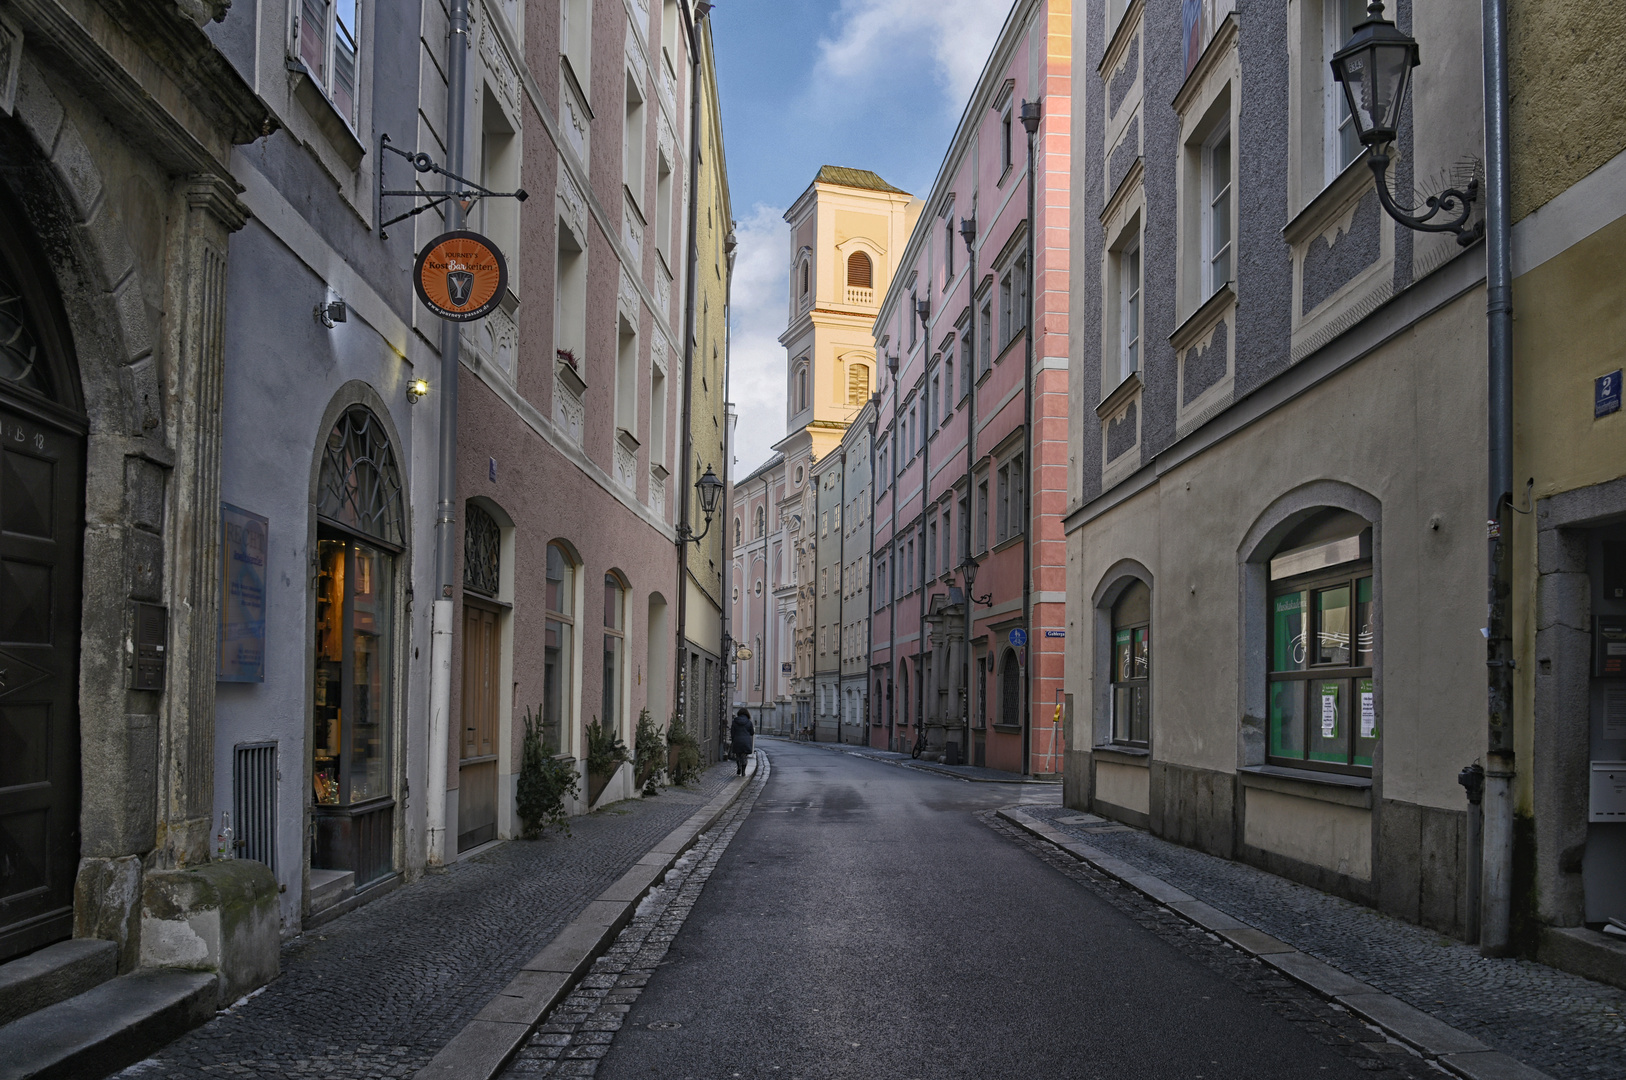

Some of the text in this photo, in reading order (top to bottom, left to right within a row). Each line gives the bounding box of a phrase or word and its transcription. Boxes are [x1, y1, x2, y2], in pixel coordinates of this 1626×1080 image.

[429, 259, 493, 271] KostBarkeiten
[1601, 376, 1612, 398] 2
[33, 432, 45, 450] 18
